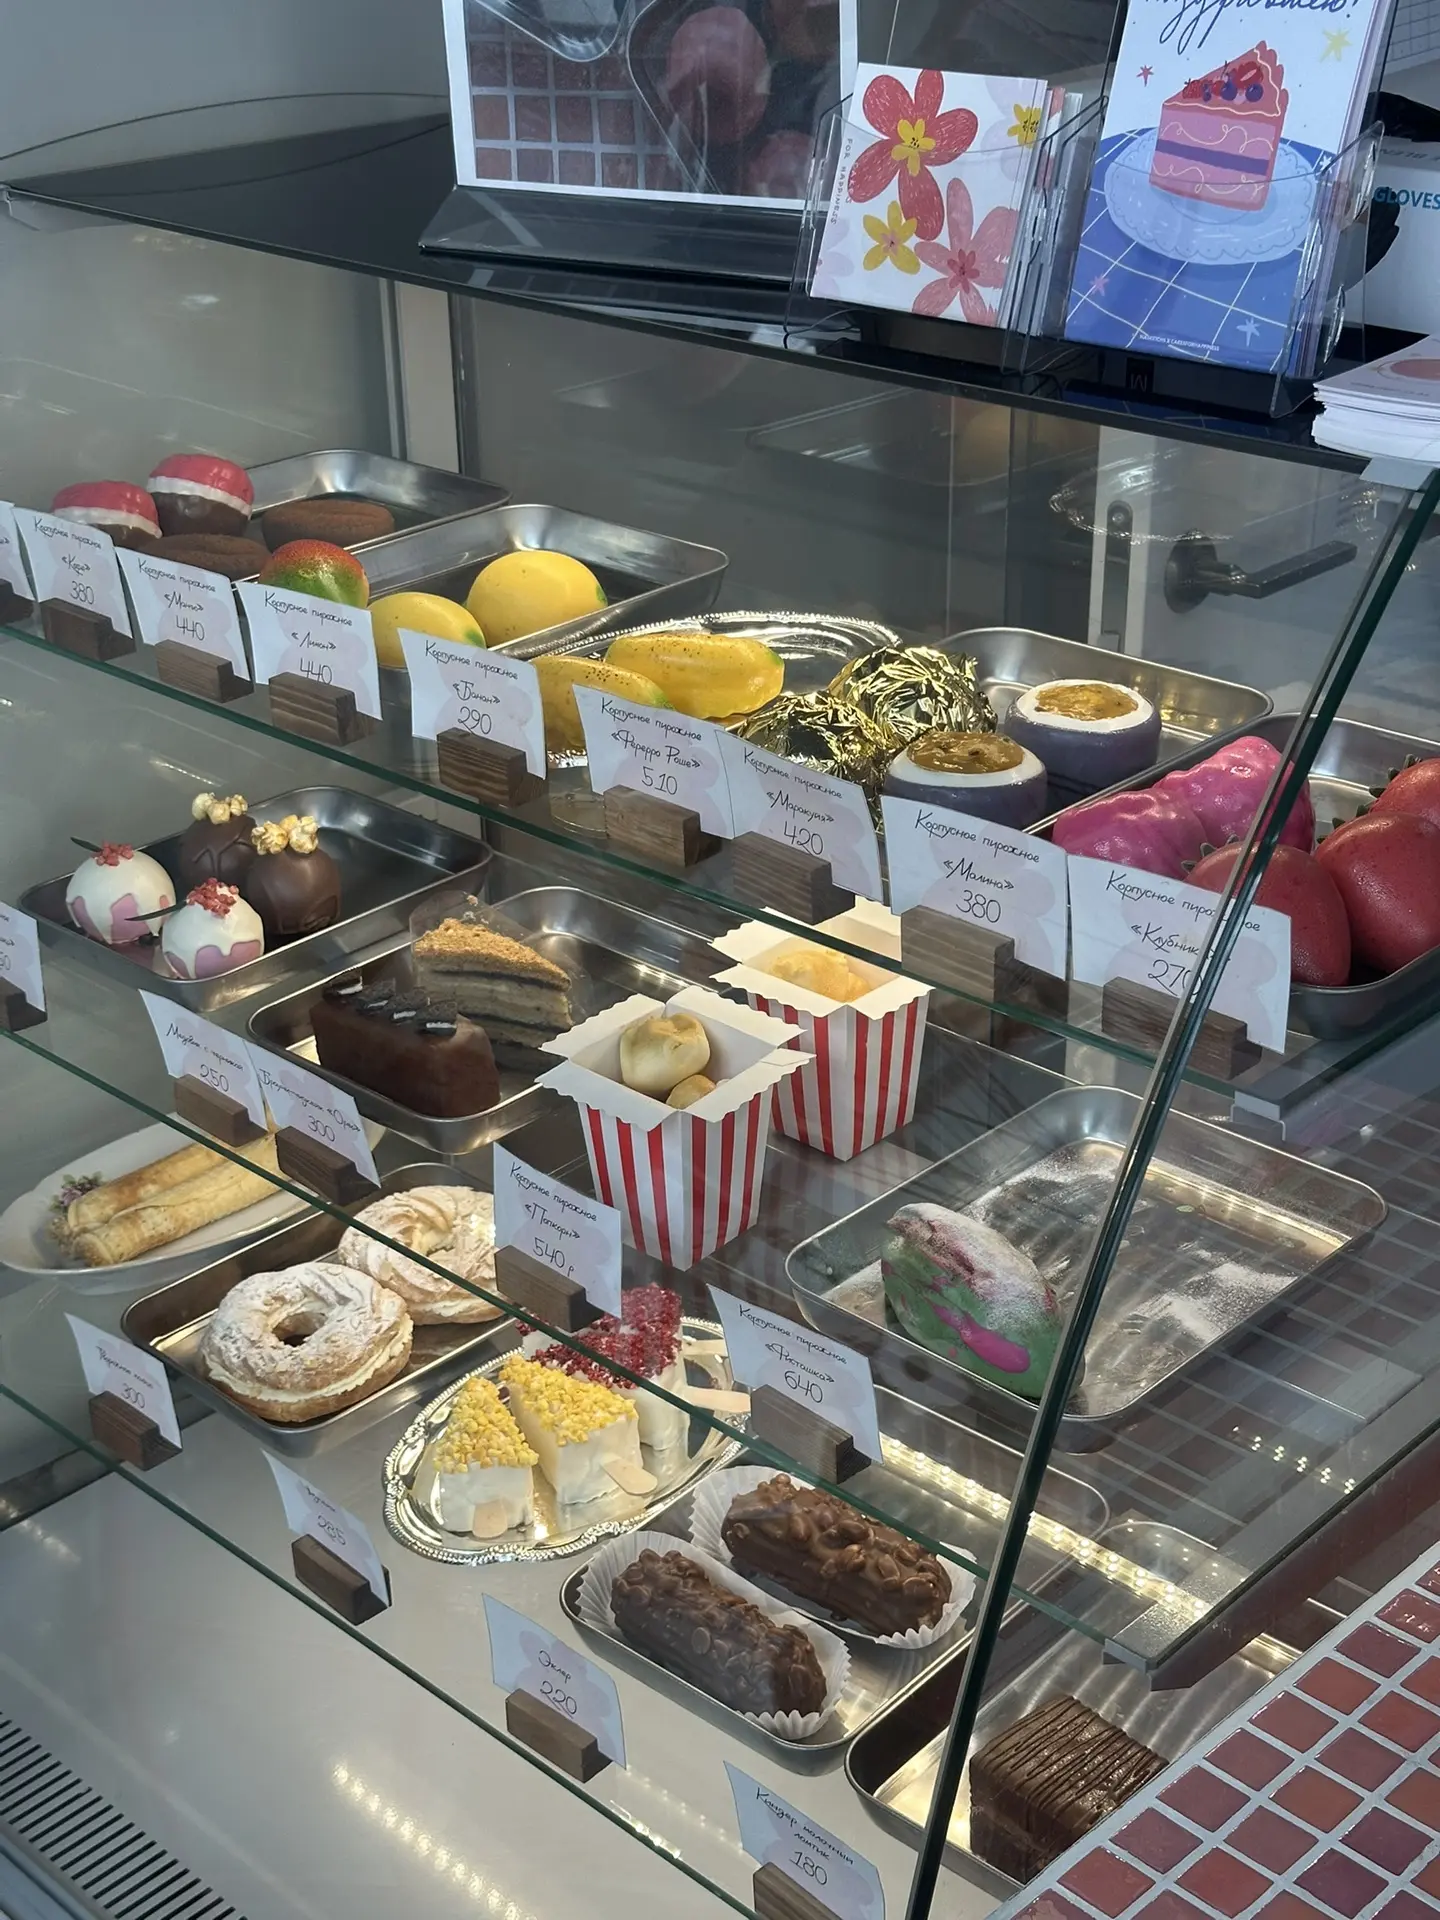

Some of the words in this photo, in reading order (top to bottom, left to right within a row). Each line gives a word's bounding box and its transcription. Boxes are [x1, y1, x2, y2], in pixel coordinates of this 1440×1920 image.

[844, 138, 853, 159] FOR
[831, 166, 846, 225] HAPPINESS
[1373, 186, 1440, 210] GLOVES
[70, 581, 95, 605] 380
[265, 590, 308, 614] Корпусное
[312, 609, 352, 626] пирожное
[176, 615, 205, 641] 440
[300, 658, 333, 685] 440
[425, 640, 470, 665] Корпусное
[474, 661, 518, 679] пирожное
[457, 706, 492, 735] 290
[601, 697, 650, 723] Корпусное
[655, 720, 702, 741] пирожное
[641, 766, 678, 796] 510
[744, 747, 790, 779] Корпусное
[794, 775, 843, 799] пирожное
[783, 821, 824, 855] 420
[914, 809, 976, 839] Корпусное
[982, 837, 1040, 863] пирожное
[943, 858, 1014, 890] «Малина»
[956, 889, 1001, 924] 380
[1106, 870, 1175, 905] Корпусное
[1182, 900, 1261, 932] пироое
[1147, 959, 1203, 997] 270
[200, 1064, 230, 1093] 250
[308, 1115, 336, 1142] 300
[510, 1162, 550, 1197] Корпусное
[553, 1195, 597, 1222] пирожное
[532, 1237, 566, 1268] 540
[739, 1304, 791, 1337] Корпусное
[796, 1335, 848, 1364] пирожное
[765, 1343, 835, 1383] «Фисташка»
[121, 1383, 146, 1409] 300
[784, 1371, 823, 1404] 640
[538, 1650, 572, 1684] Эклер
[539, 1680, 577, 1719] 220
[756, 1787, 798, 1828] Киндер
[794, 1833, 831, 1861] ломтик
[789, 1851, 828, 1886] 180
